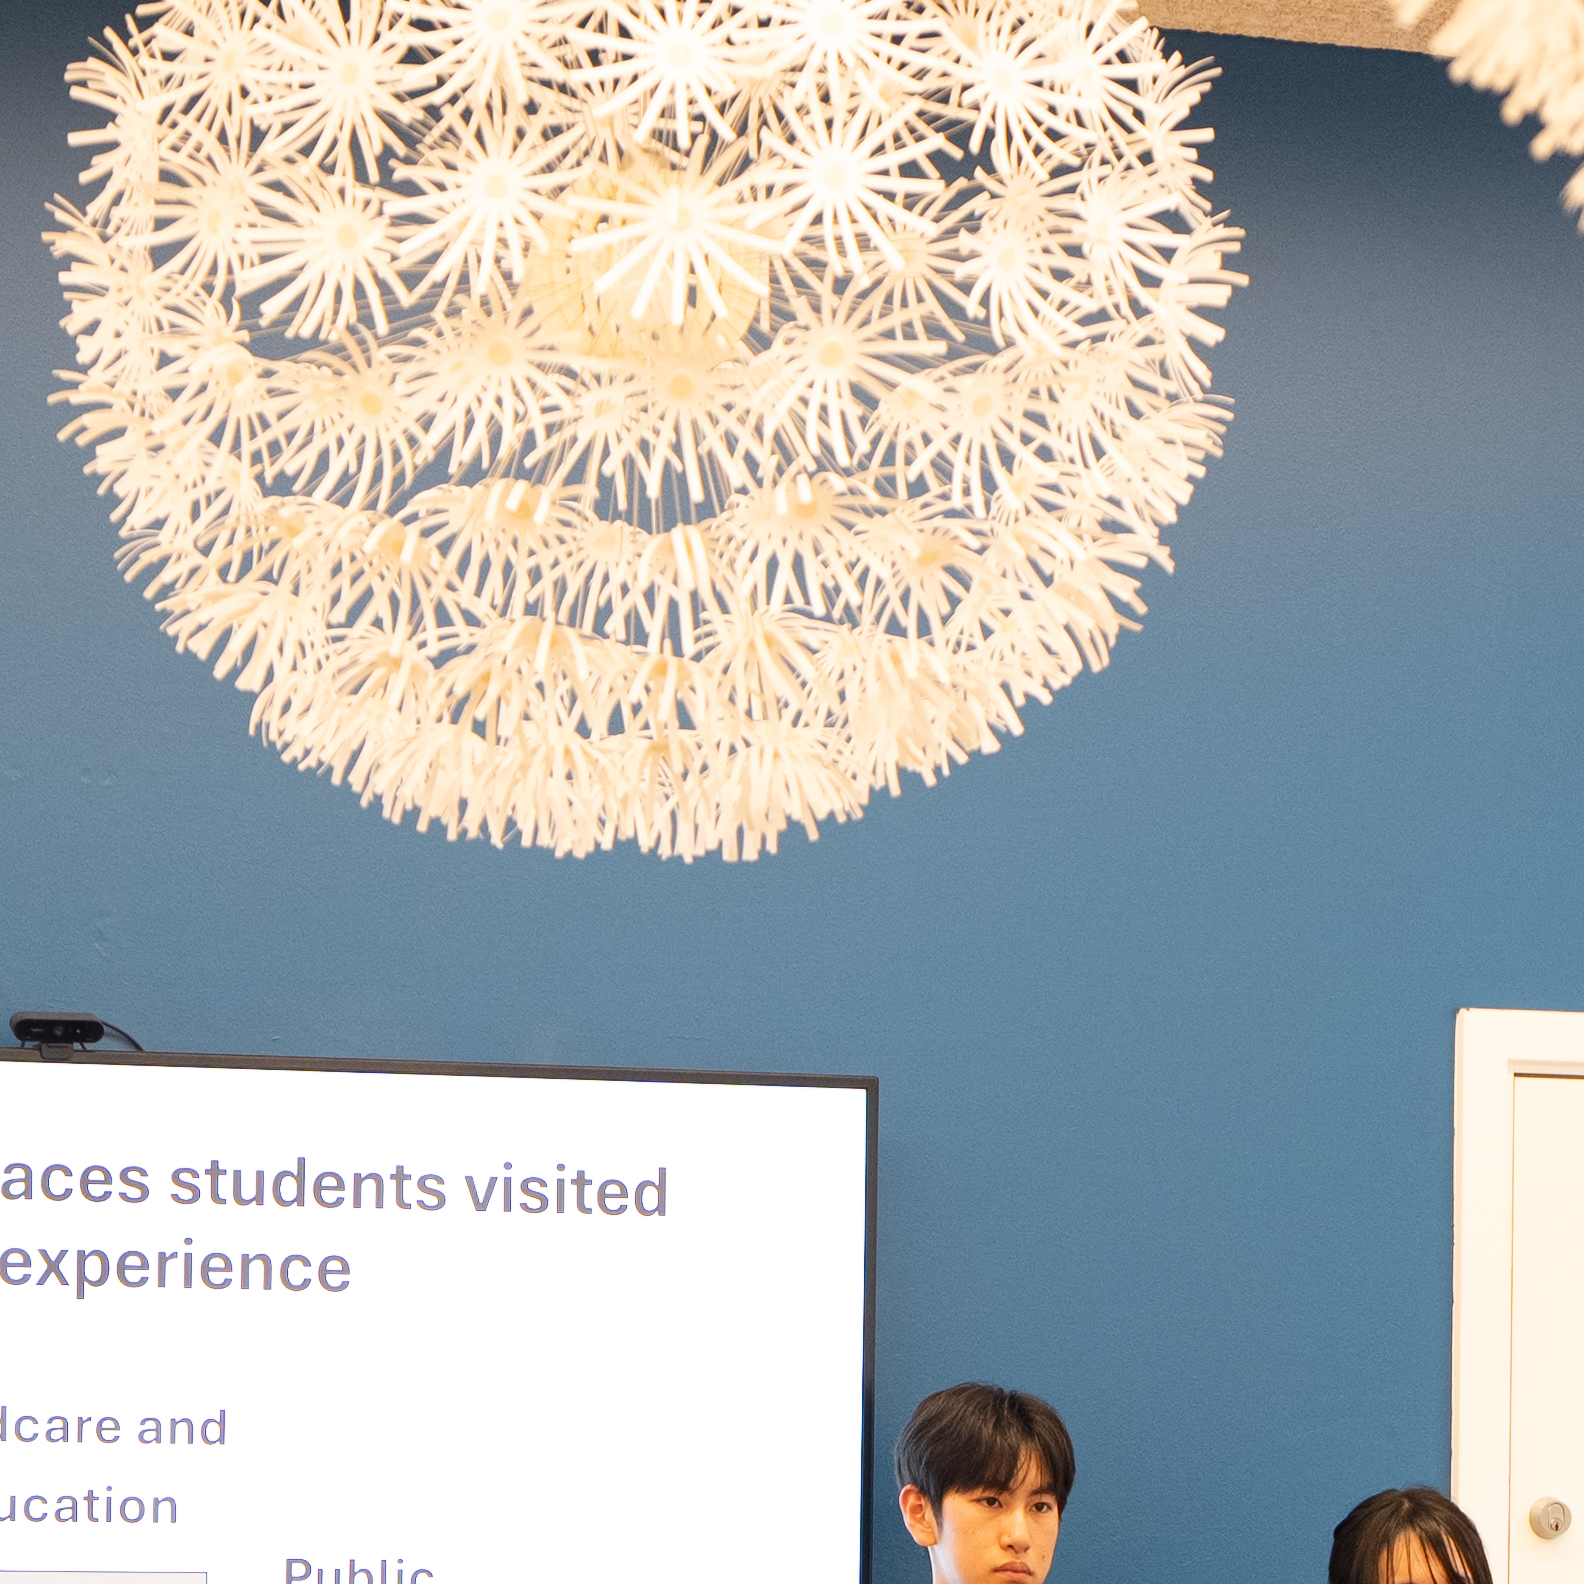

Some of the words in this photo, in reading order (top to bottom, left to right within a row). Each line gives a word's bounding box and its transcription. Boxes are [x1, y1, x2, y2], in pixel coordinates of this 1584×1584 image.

[170, 1157, 446, 1211] students
[465, 1162, 666, 1216] visited
[0, 1237, 350, 1299] experience
[138, 1409, 225, 1445] and
